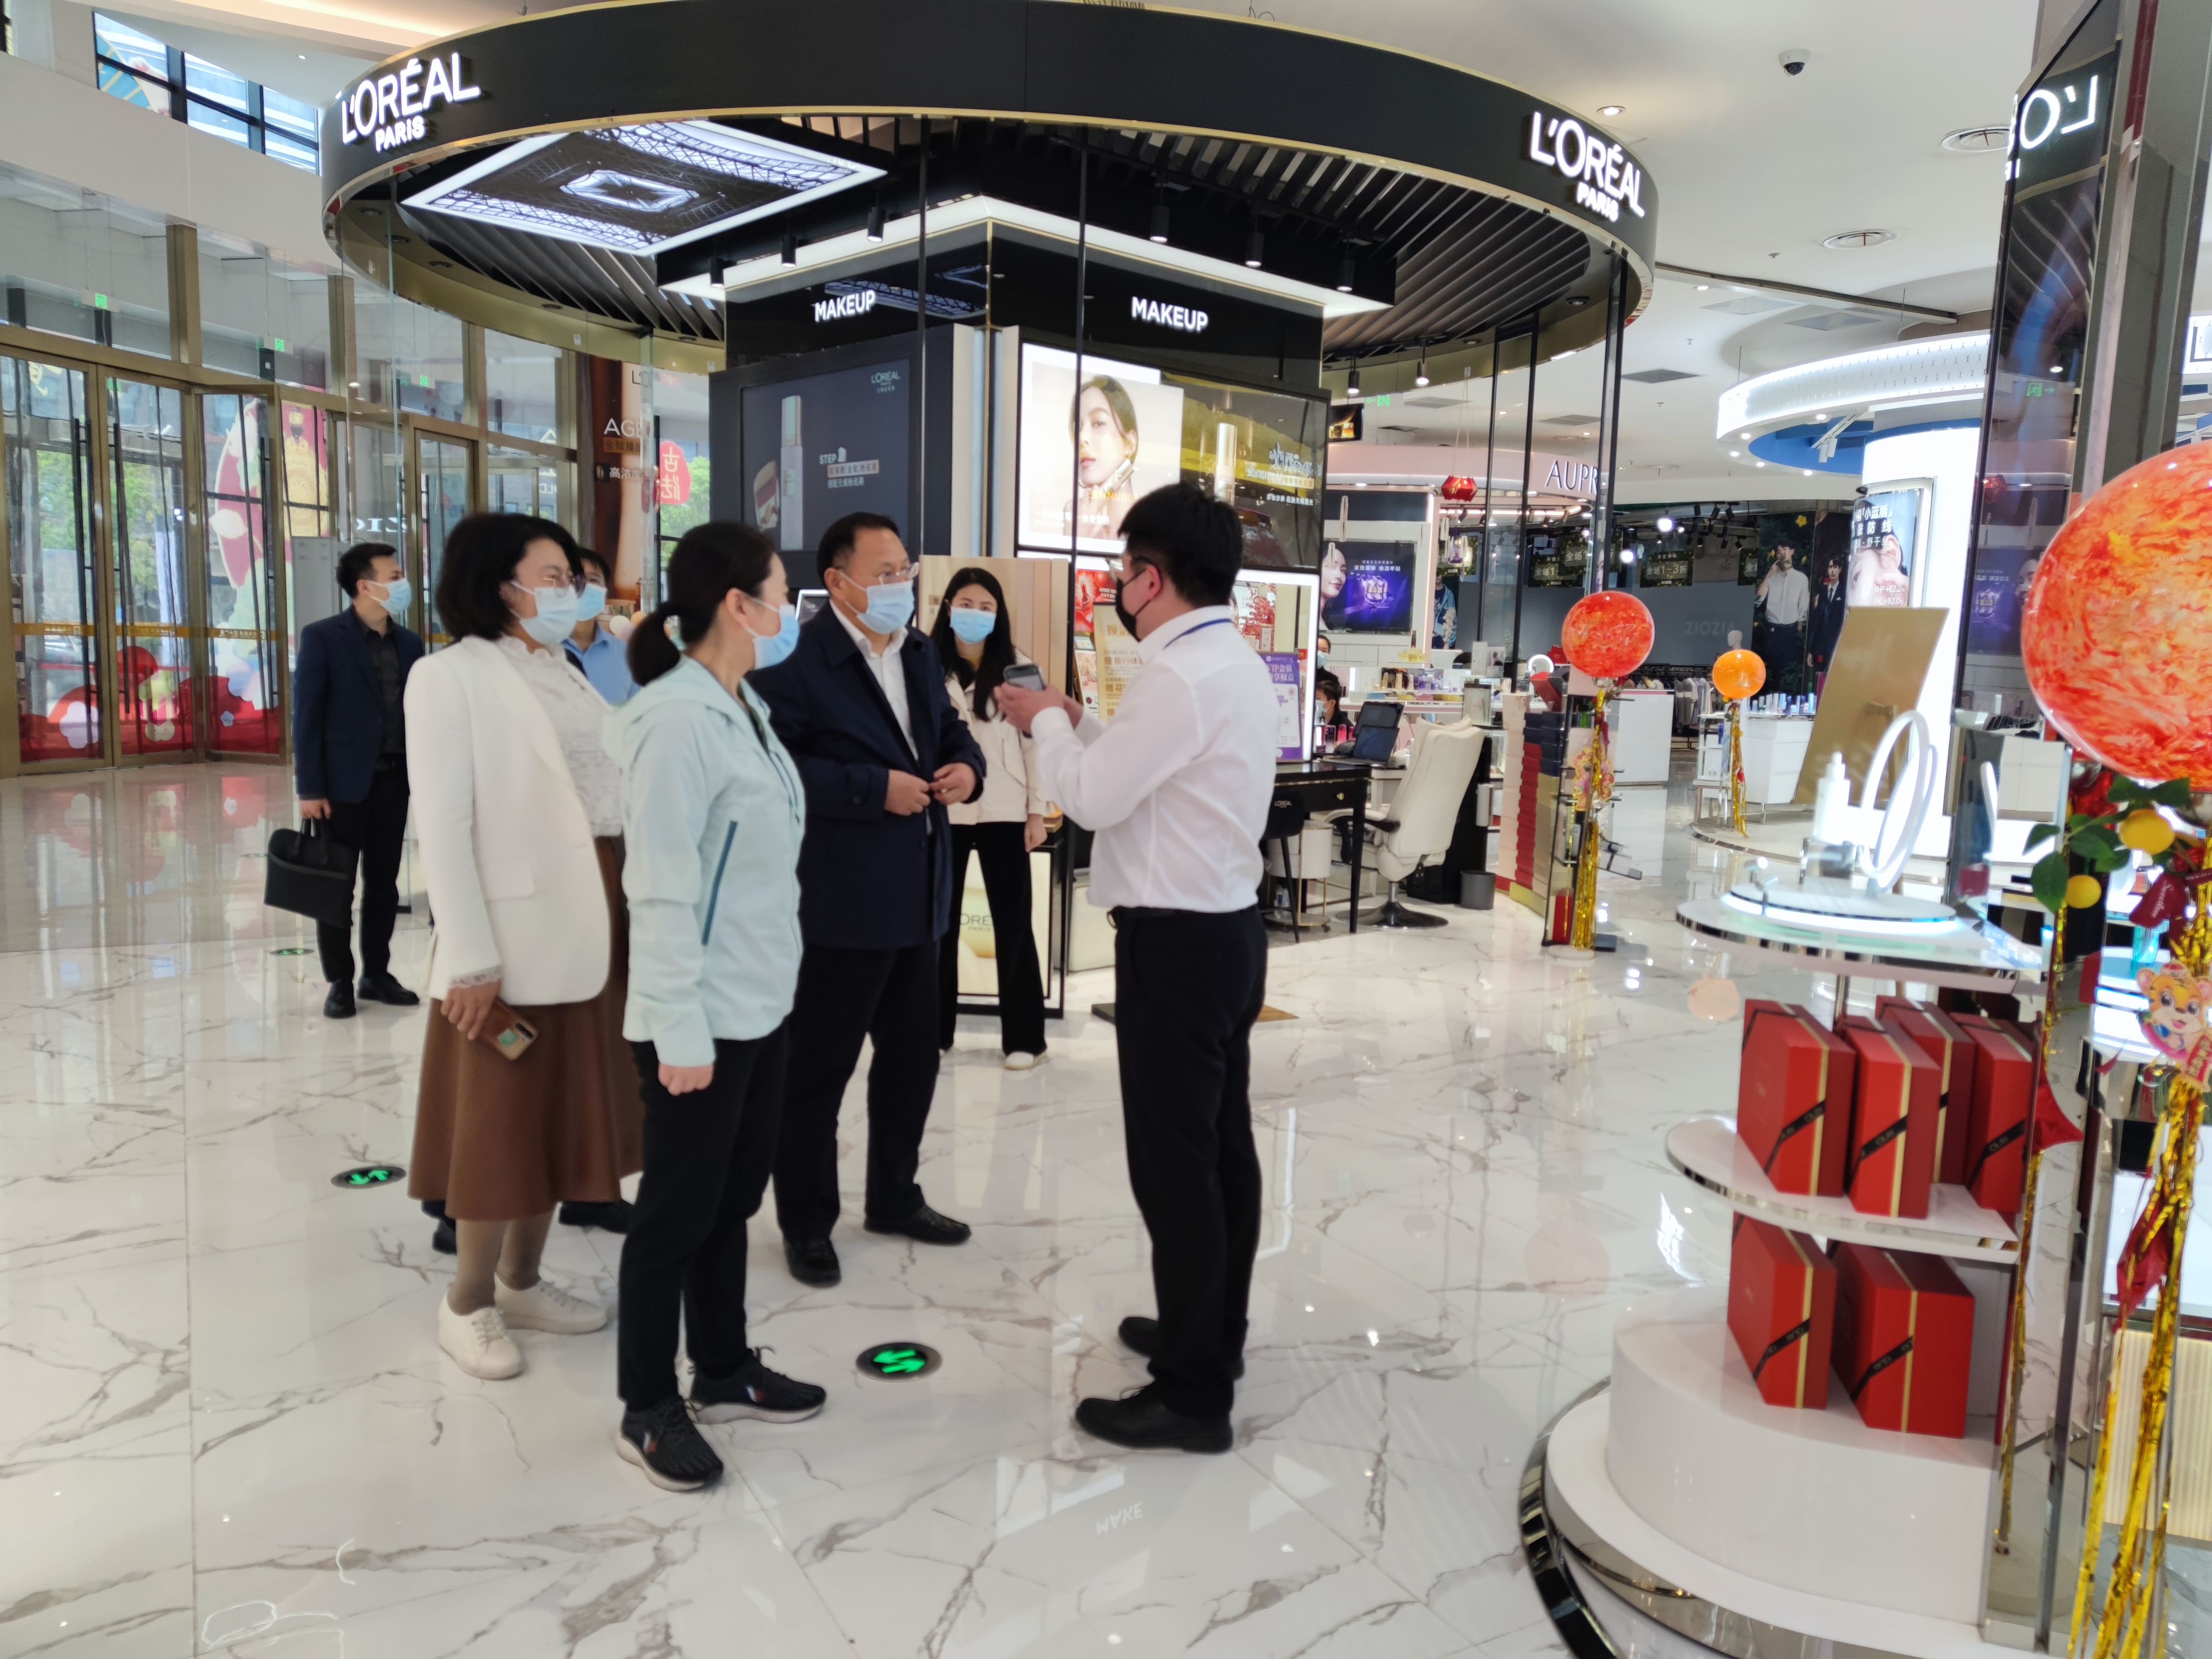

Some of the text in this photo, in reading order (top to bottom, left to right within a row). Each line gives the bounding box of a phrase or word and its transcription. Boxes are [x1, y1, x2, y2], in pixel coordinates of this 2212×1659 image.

[342, 52, 481, 145] L'ORÉAL
[375, 115, 426, 153] PARIS
[1530, 111, 1645, 218] L'ORÉAL
[1576, 181, 1620, 223] PARIS
[814, 289, 876, 323] MAKEUP
[1131, 296, 1209, 332] MAKEUP
[819, 453, 837, 465] STEP
